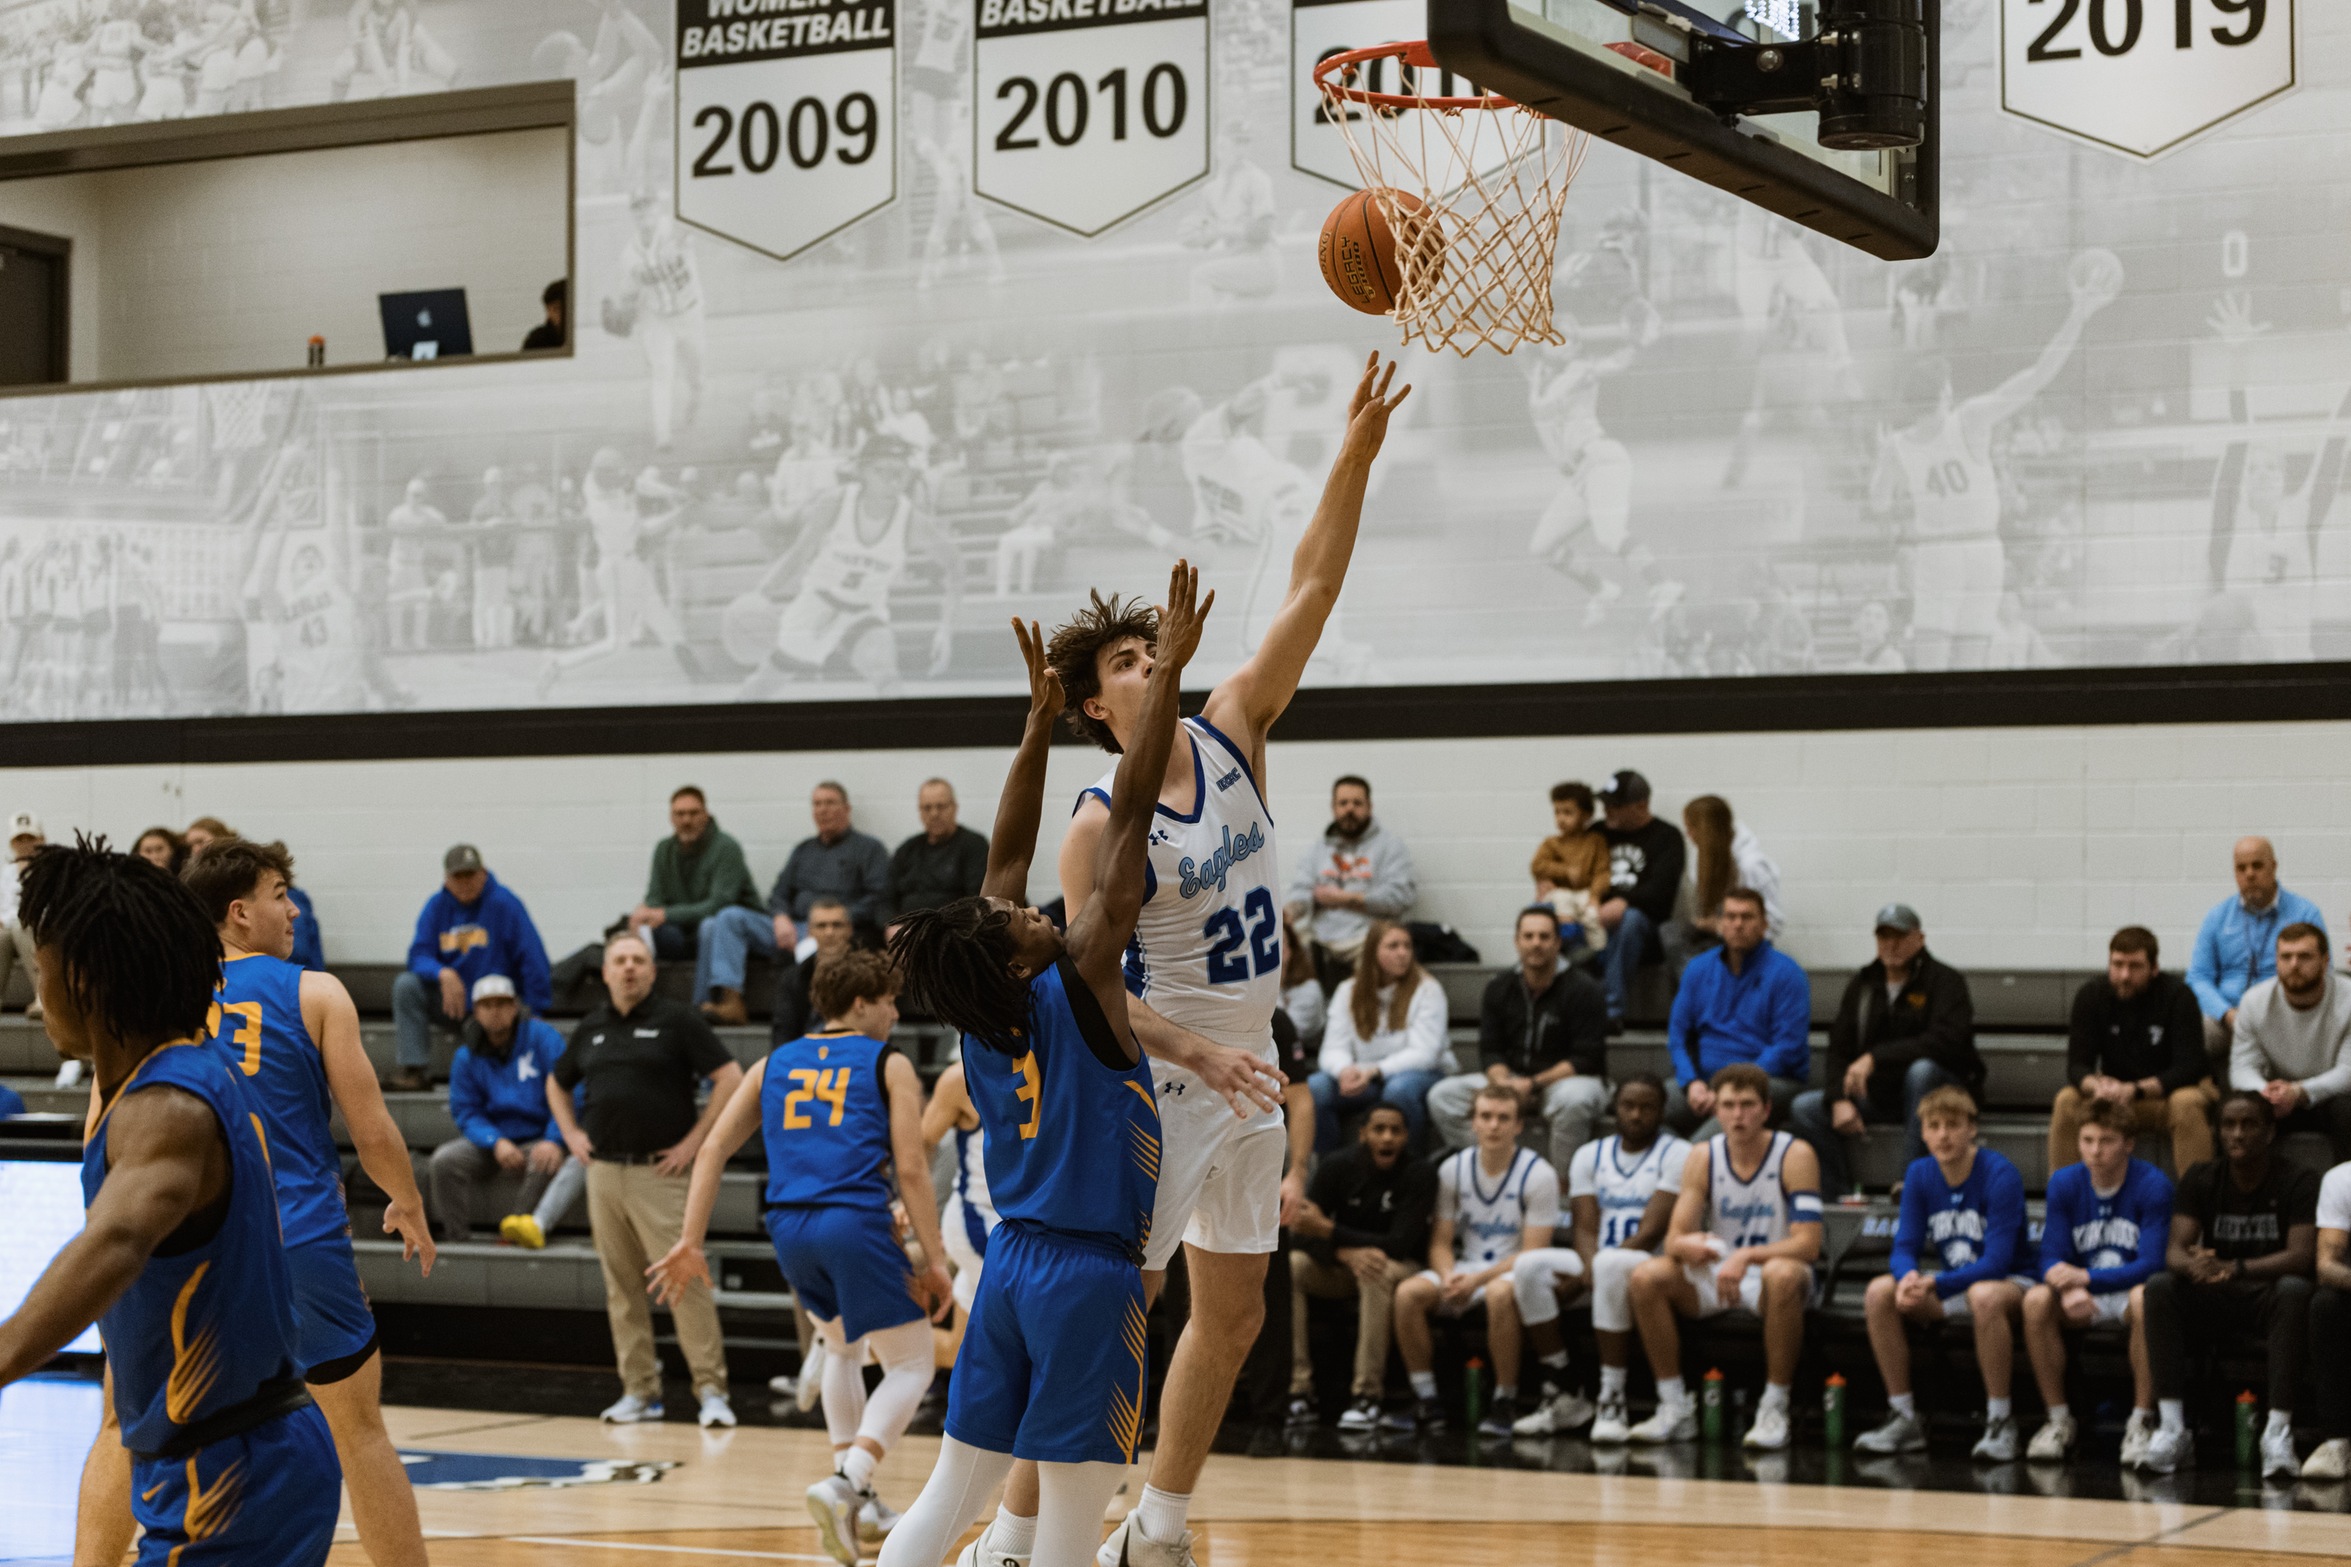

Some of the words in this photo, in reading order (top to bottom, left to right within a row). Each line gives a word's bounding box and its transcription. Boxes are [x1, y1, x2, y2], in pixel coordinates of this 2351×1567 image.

[680, 7, 891, 59] BASKETBALL
[692, 91, 879, 179] 2009
[994, 62, 1188, 152] 2010
[1340, 234, 1371, 304] LEGACY
[1178, 820, 1265, 899] Eagles
[1202, 884, 1281, 985] 22
[205, 1000, 263, 1076] 3
[783, 1066, 852, 1131] 24
[1012, 1048, 1042, 1140] 3
